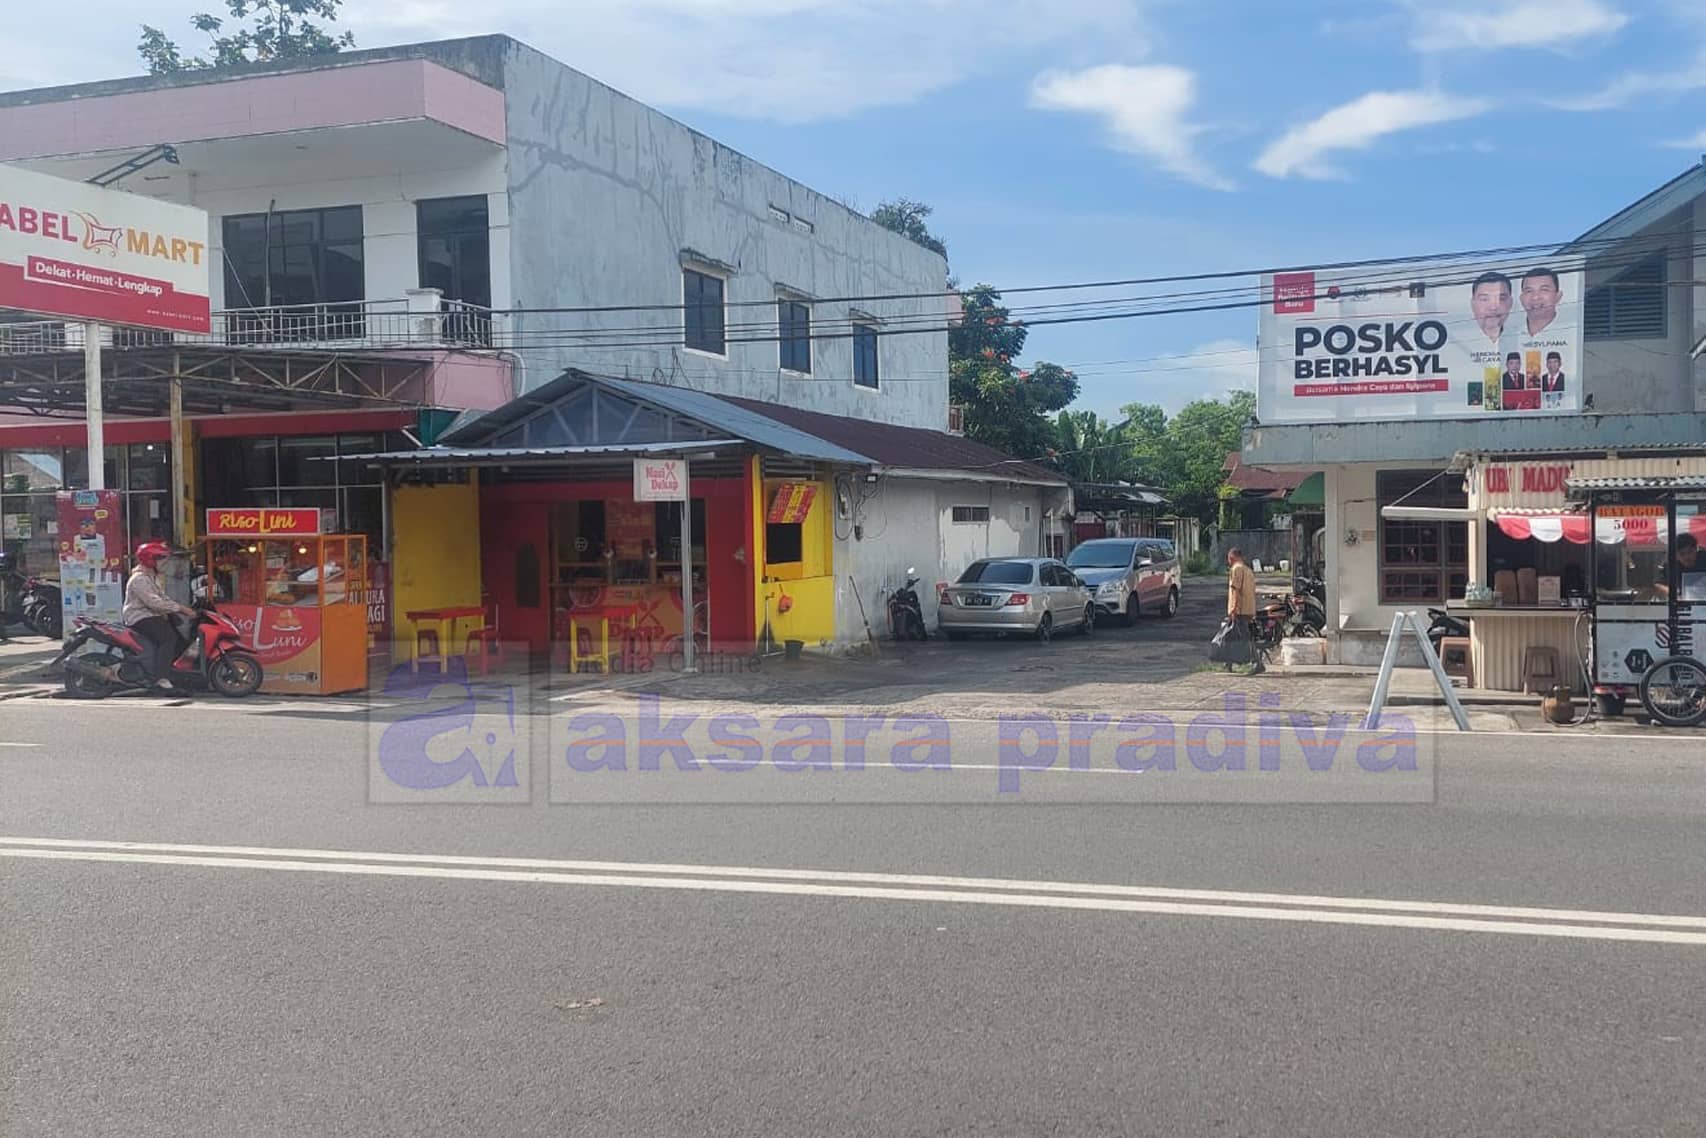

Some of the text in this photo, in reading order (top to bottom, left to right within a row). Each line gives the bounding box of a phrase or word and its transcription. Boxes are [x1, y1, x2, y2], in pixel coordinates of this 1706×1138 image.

[126, 228, 204, 265] MART
[35, 261, 163, 297] Dekat Hemat Lengkap
[1294, 320, 1448, 356] POSKO
[1294, 354, 1449, 380] BERHASYL
[1521, 465, 1571, 493] MADU
[1613, 519, 1648, 530] 5000
